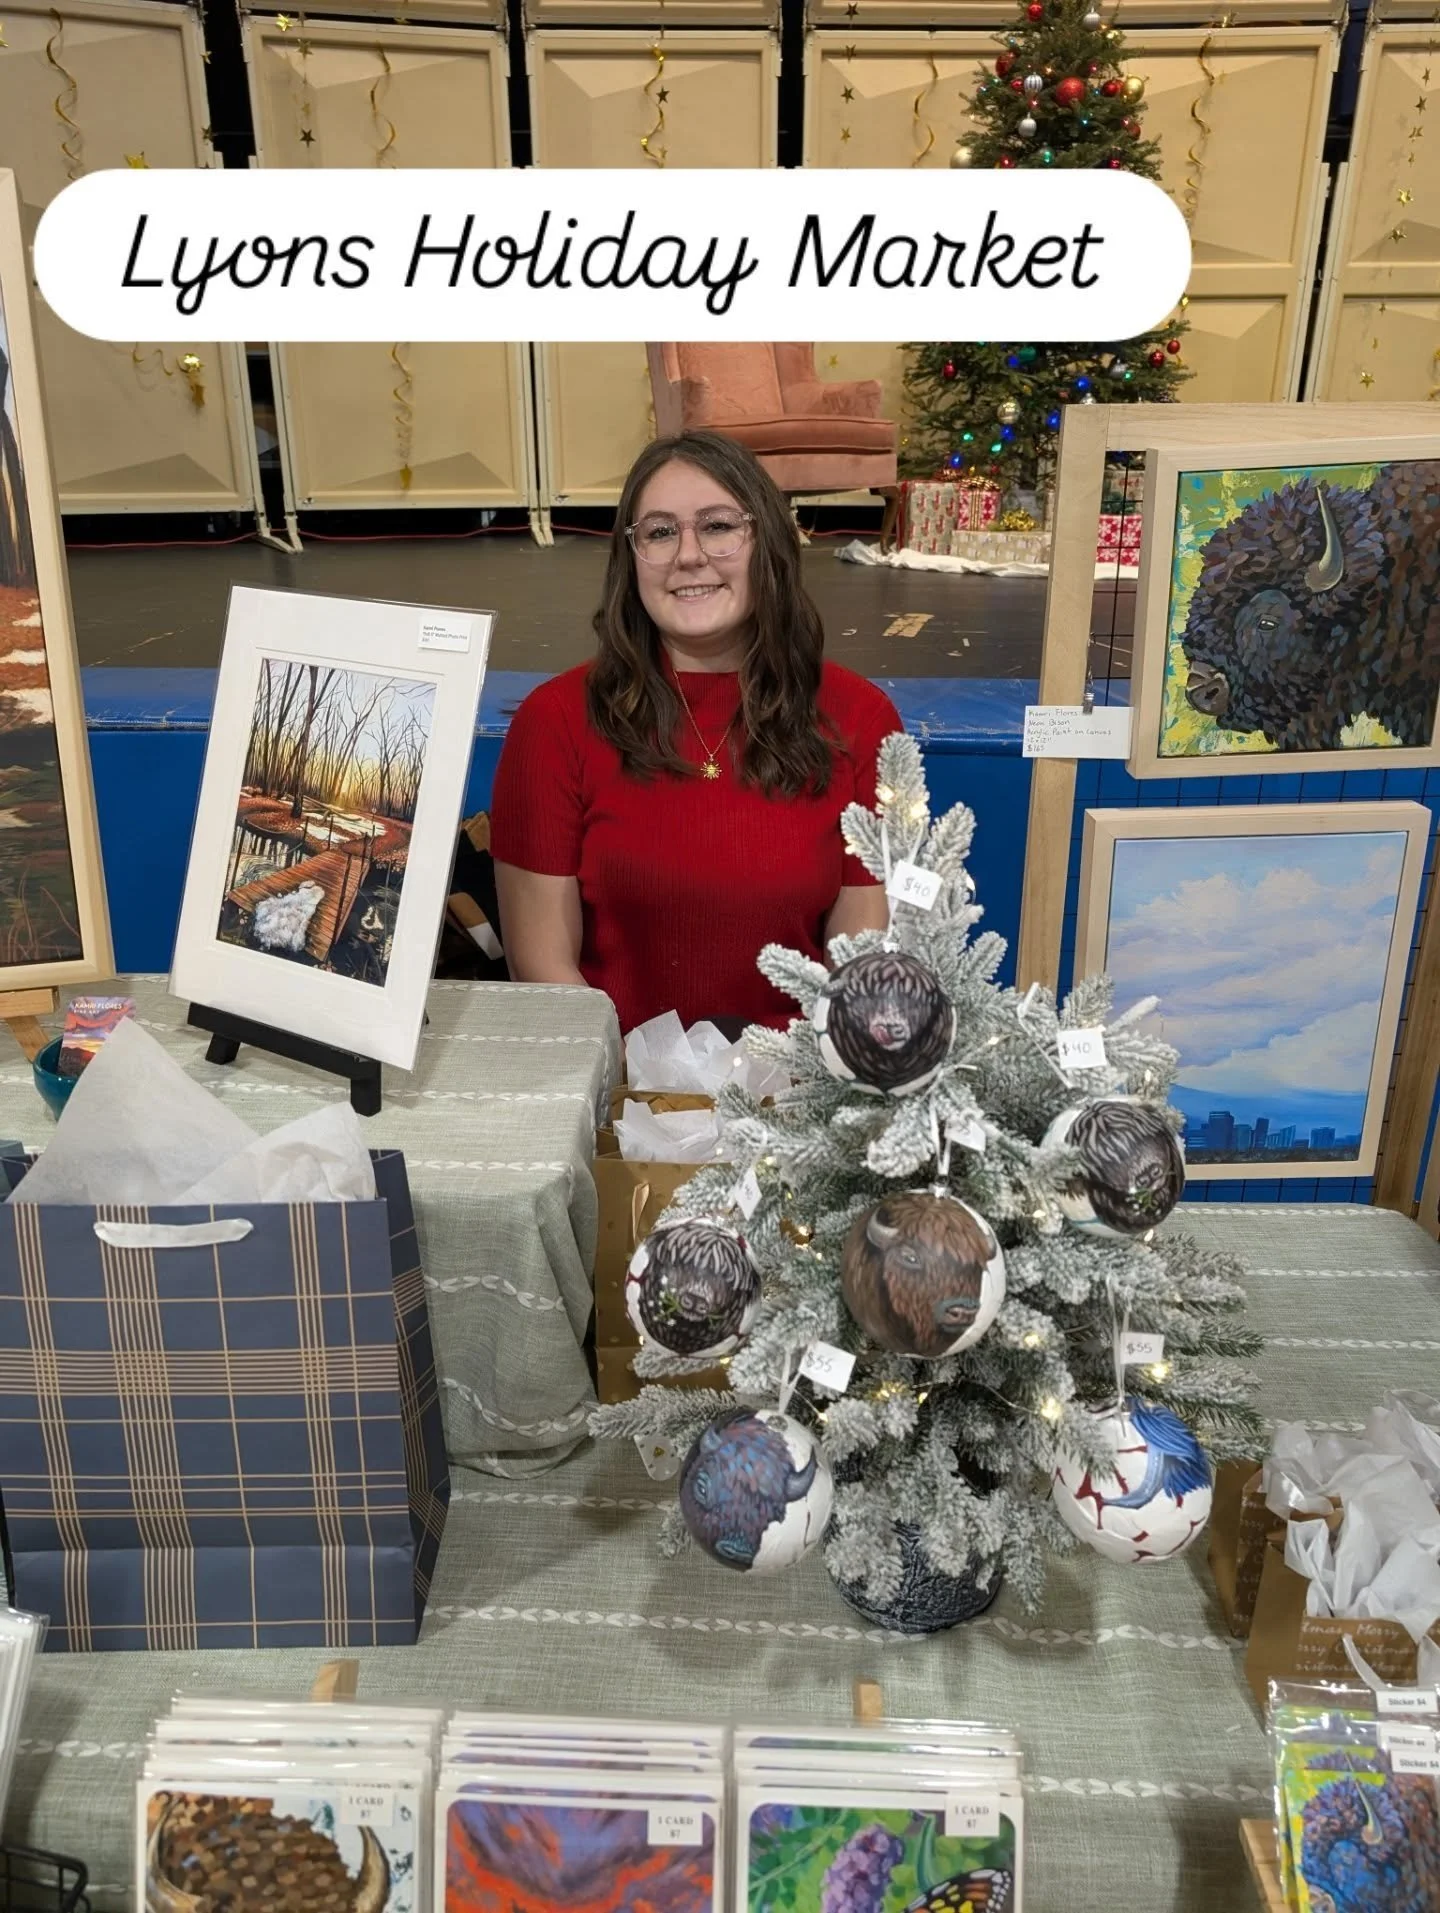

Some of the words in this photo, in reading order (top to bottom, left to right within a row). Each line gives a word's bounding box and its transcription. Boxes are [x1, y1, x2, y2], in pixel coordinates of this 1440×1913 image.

[1049, 719, 1070, 727] Bison
[903, 876, 930, 897] $40
[1062, 1041, 1091, 1057] $40
[1126, 1342, 1153, 1355] $55
[806, 1351, 833, 1373] $55
[1356, 1623, 1400, 1639] Merry
[1388, 1697, 1414, 1706] Sticker
[1399, 1759, 1427, 1768] Sticker
[355, 1797, 384, 1805] CARD
[961, 1805, 990, 1815] CARD
[665, 1815, 694, 1825] CARD
